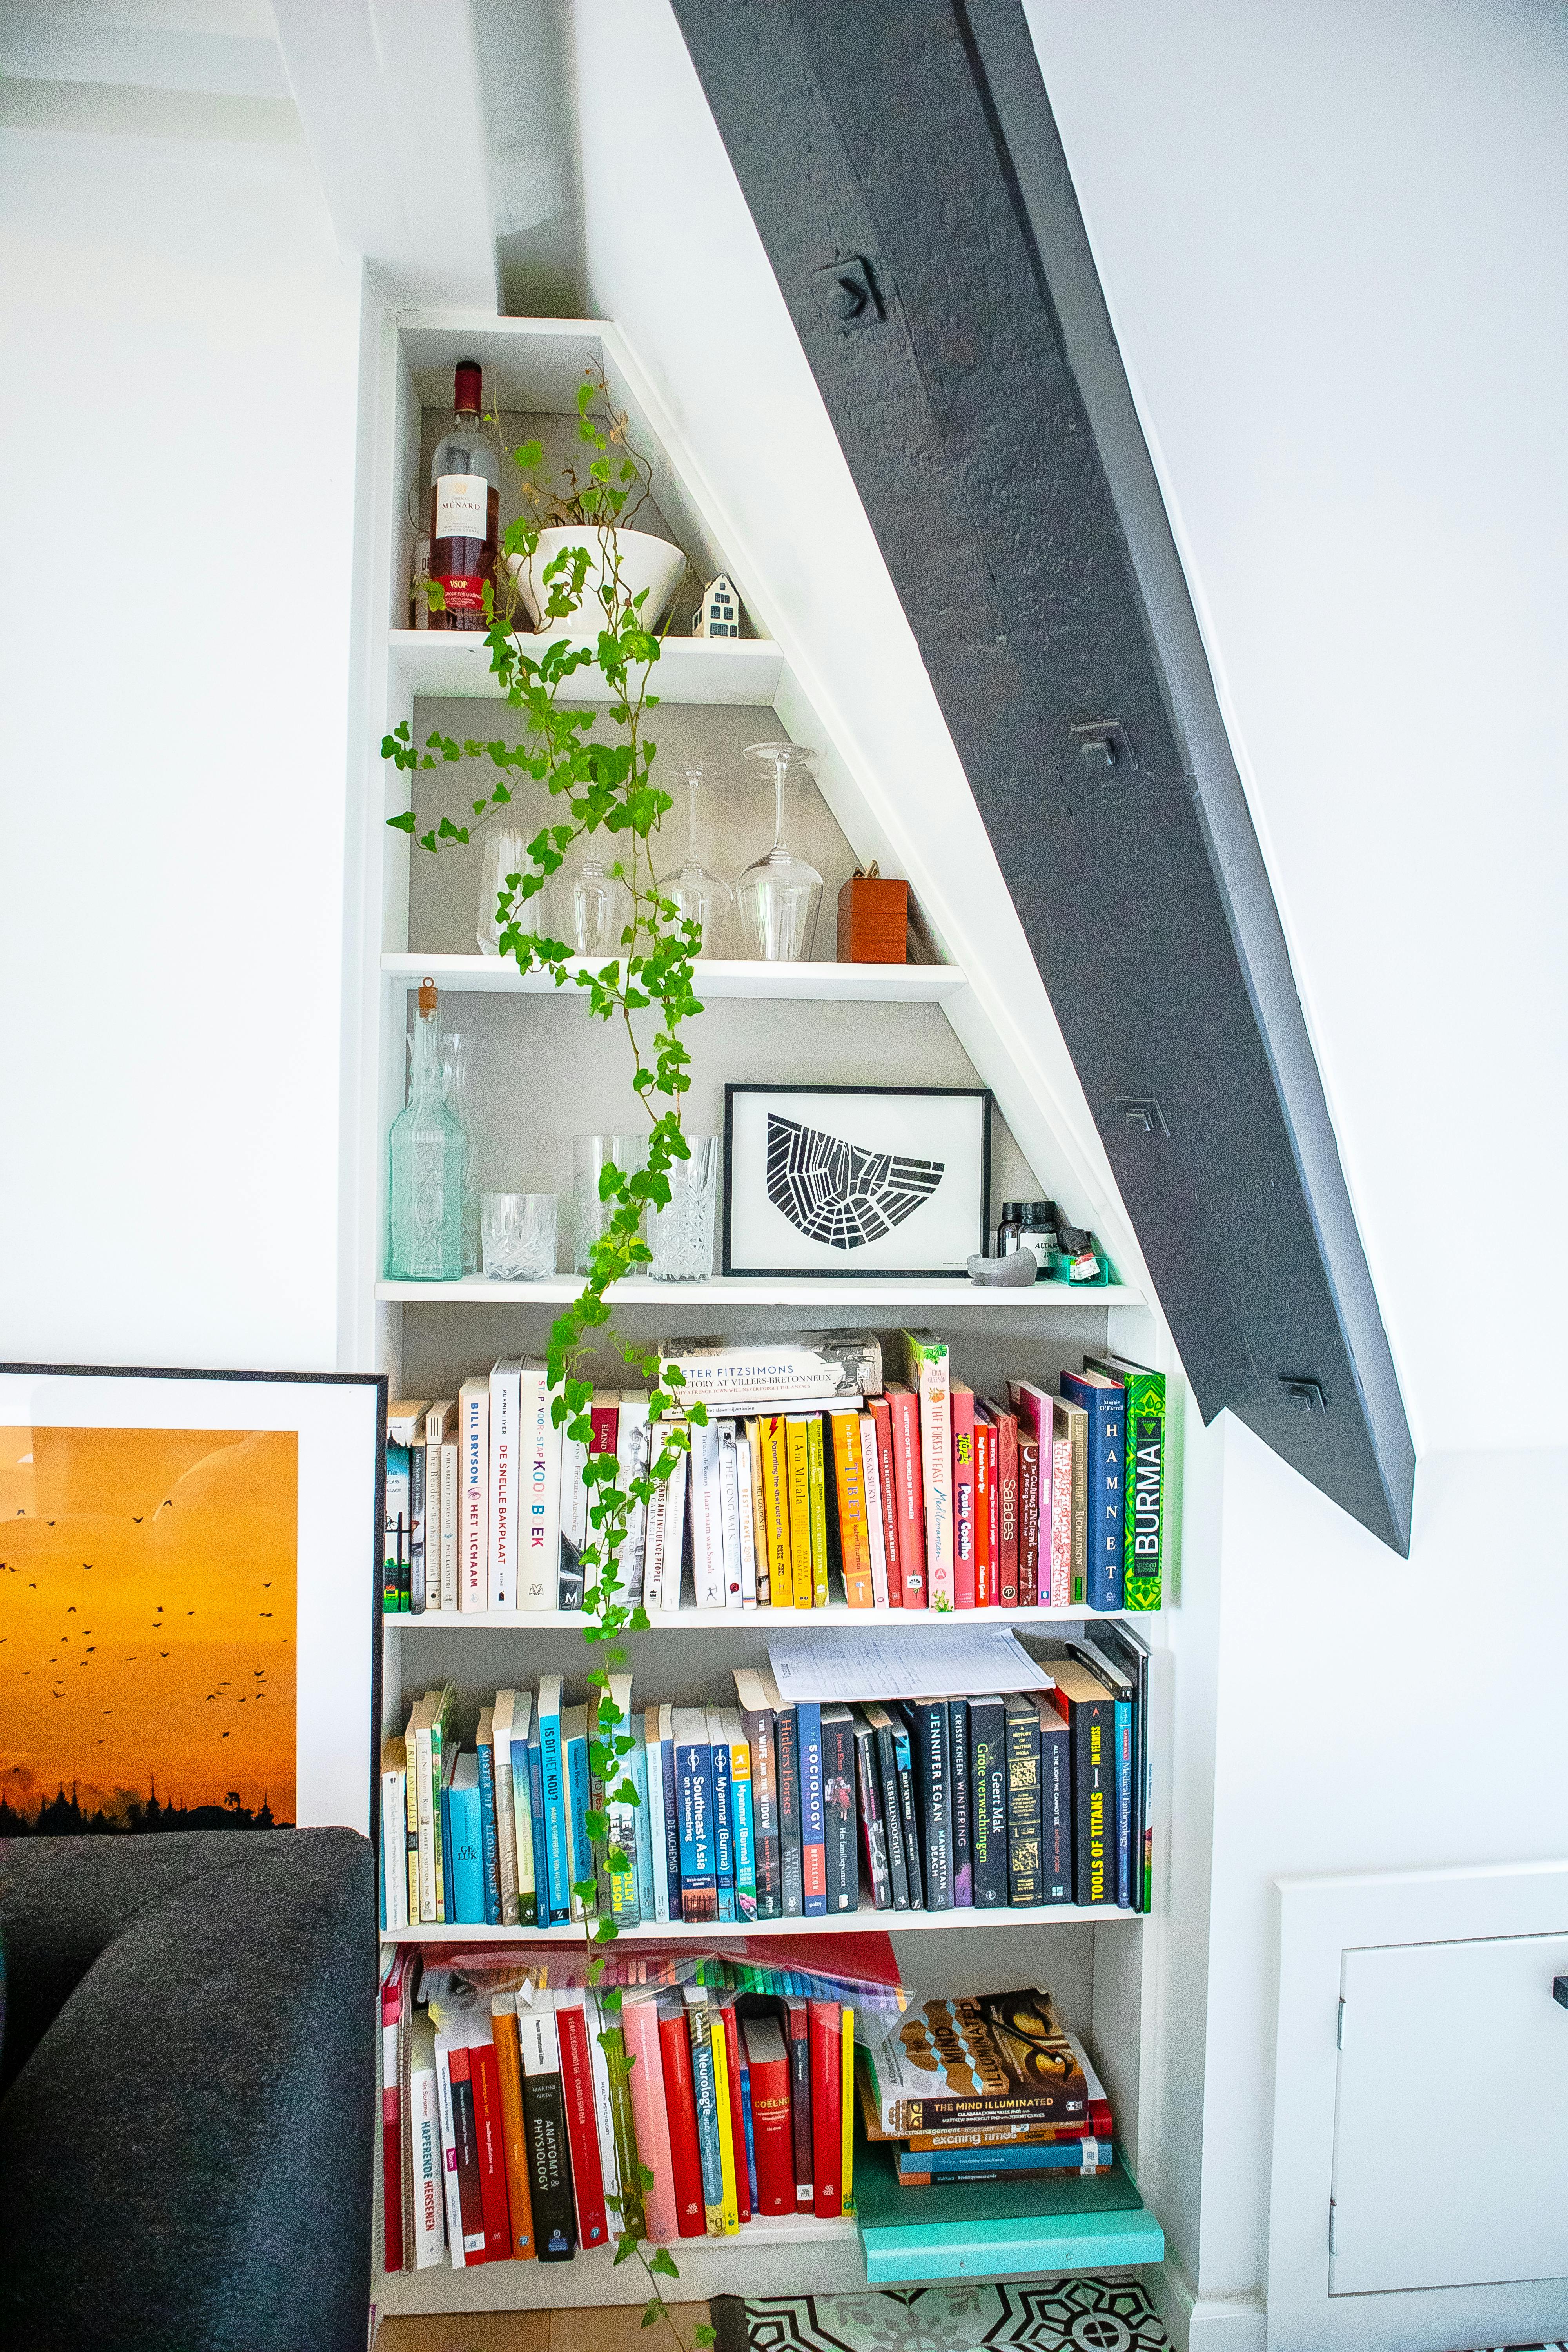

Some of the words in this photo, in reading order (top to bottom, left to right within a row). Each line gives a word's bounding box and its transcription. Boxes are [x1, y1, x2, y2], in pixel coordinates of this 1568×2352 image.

[681, 1369, 712, 1378] ETER
[717, 1365, 793, 1377] FITZSIMONS
[731, 1374, 831, 1387] VILLERS-BRETONNEUX
[470, 1403, 479, 1429] BILL
[932, 1406, 943, 1422] THE
[470, 1434, 479, 1483] BRYSON
[499, 1445, 508, 1459] DE
[794, 1444, 803, 1462] Am
[864, 1432, 873, 1456] AUNG
[932, 1426, 943, 1454] FOREST
[499, 1463, 507, 1503] SNELLE
[623, 1465, 630, 1475] De
[795, 1467, 805, 1504] Malala
[932, 1458, 944, 1483] FEAST
[531, 1461, 546, 1548] KOOKBOEK
[844, 1462, 860, 1521] TIBET
[961, 1485, 971, 1518] Paulo
[1003, 1479, 1016, 1540] Salades
[1135, 1443, 1161, 1554] BURMA
[470, 1504, 478, 1526] HET
[498, 1508, 506, 1564] BAKPLAAT
[655, 1520, 663, 1555] INFLUENCE
[960, 1522, 971, 1561] Coelho
[1075, 1511, 1084, 1565] RICHARDSON
[653, 1558, 662, 1582] PEOPLE
[544, 1727, 555, 1738] IS
[545, 1739, 556, 1754] DIT
[758, 1735, 768, 1759] WIFE
[781, 1719, 794, 1768] Hitler's
[930, 1713, 942, 1780] JENNIFER
[1091, 1726, 1100, 1752] FERRISS
[482, 1750, 490, 1788] MISTER
[546, 1757, 557, 1771] HET
[977, 1743, 989, 1776] Grote
[547, 1774, 558, 1801] NOU?
[684, 1777, 691, 1787] on
[783, 1770, 793, 1815] Horses
[809, 1744, 820, 1831] SOCIOLOGY
[992, 1772, 1003, 1804] Geert
[684, 1797, 693, 1842] shoestring
[693, 1776, 706, 1840] Southeast
[715, 1777, 728, 1825] Myanmar
[737, 1784, 746, 1825] Myanmar
[760, 1794, 770, 1829] WIDOW
[933, 1784, 942, 1821] EGAN
[956, 1781, 966, 1847] WINTERING
[1091, 1792, 1103, 1837] TITANS
[886, 1780, 901, 1866] REBELLENDOCHTER
[976, 1779, 990, 1863] verwachtingen
[992, 1807, 1003, 1833] Mak
[1120, 1797, 1129, 1848] Embryology
[486, 1825, 495, 1858] LLOYD
[668, 1831, 677, 1873] ALCHEMIST
[696, 1844, 707, 1869] Asia
[717, 1828, 729, 1871] (Burma)
[739, 1828, 750, 1864] (Burma)
[938, 1830, 947, 1889] MANHATTAN
[1091, 1840, 1103, 1857] OF
[486, 1862, 496, 1894] JONES
[784, 1851, 792, 1886] BRAND
[791, 1847, 800, 1888] ARTHUR
[811, 1848, 819, 1890] NETTLETON
[838, 1840, 848, 1886] familieportret
[1091, 1860, 1103, 1901] TOOLS
[694, 2013, 704, 2043] Gelmers
[935, 2027, 964, 2064] MIND
[754, 2097, 790, 2109] COELHO
[934, 2104, 954, 2112] THE
[956, 2102, 982, 2111] MIND
[985, 2098, 1054, 2109] ILLUMINATED
[698, 2054, 712, 2115] Neurologie
[705, 2134, 716, 2198] verpleegkundigen
[421, 2121, 433, 2179] HAPERENDE
[533, 2119, 548, 2190] PHYSIOLOGY
[544, 2120, 559, 2176] ANATOMY
[423, 2180, 435, 2232] HERSENEN
